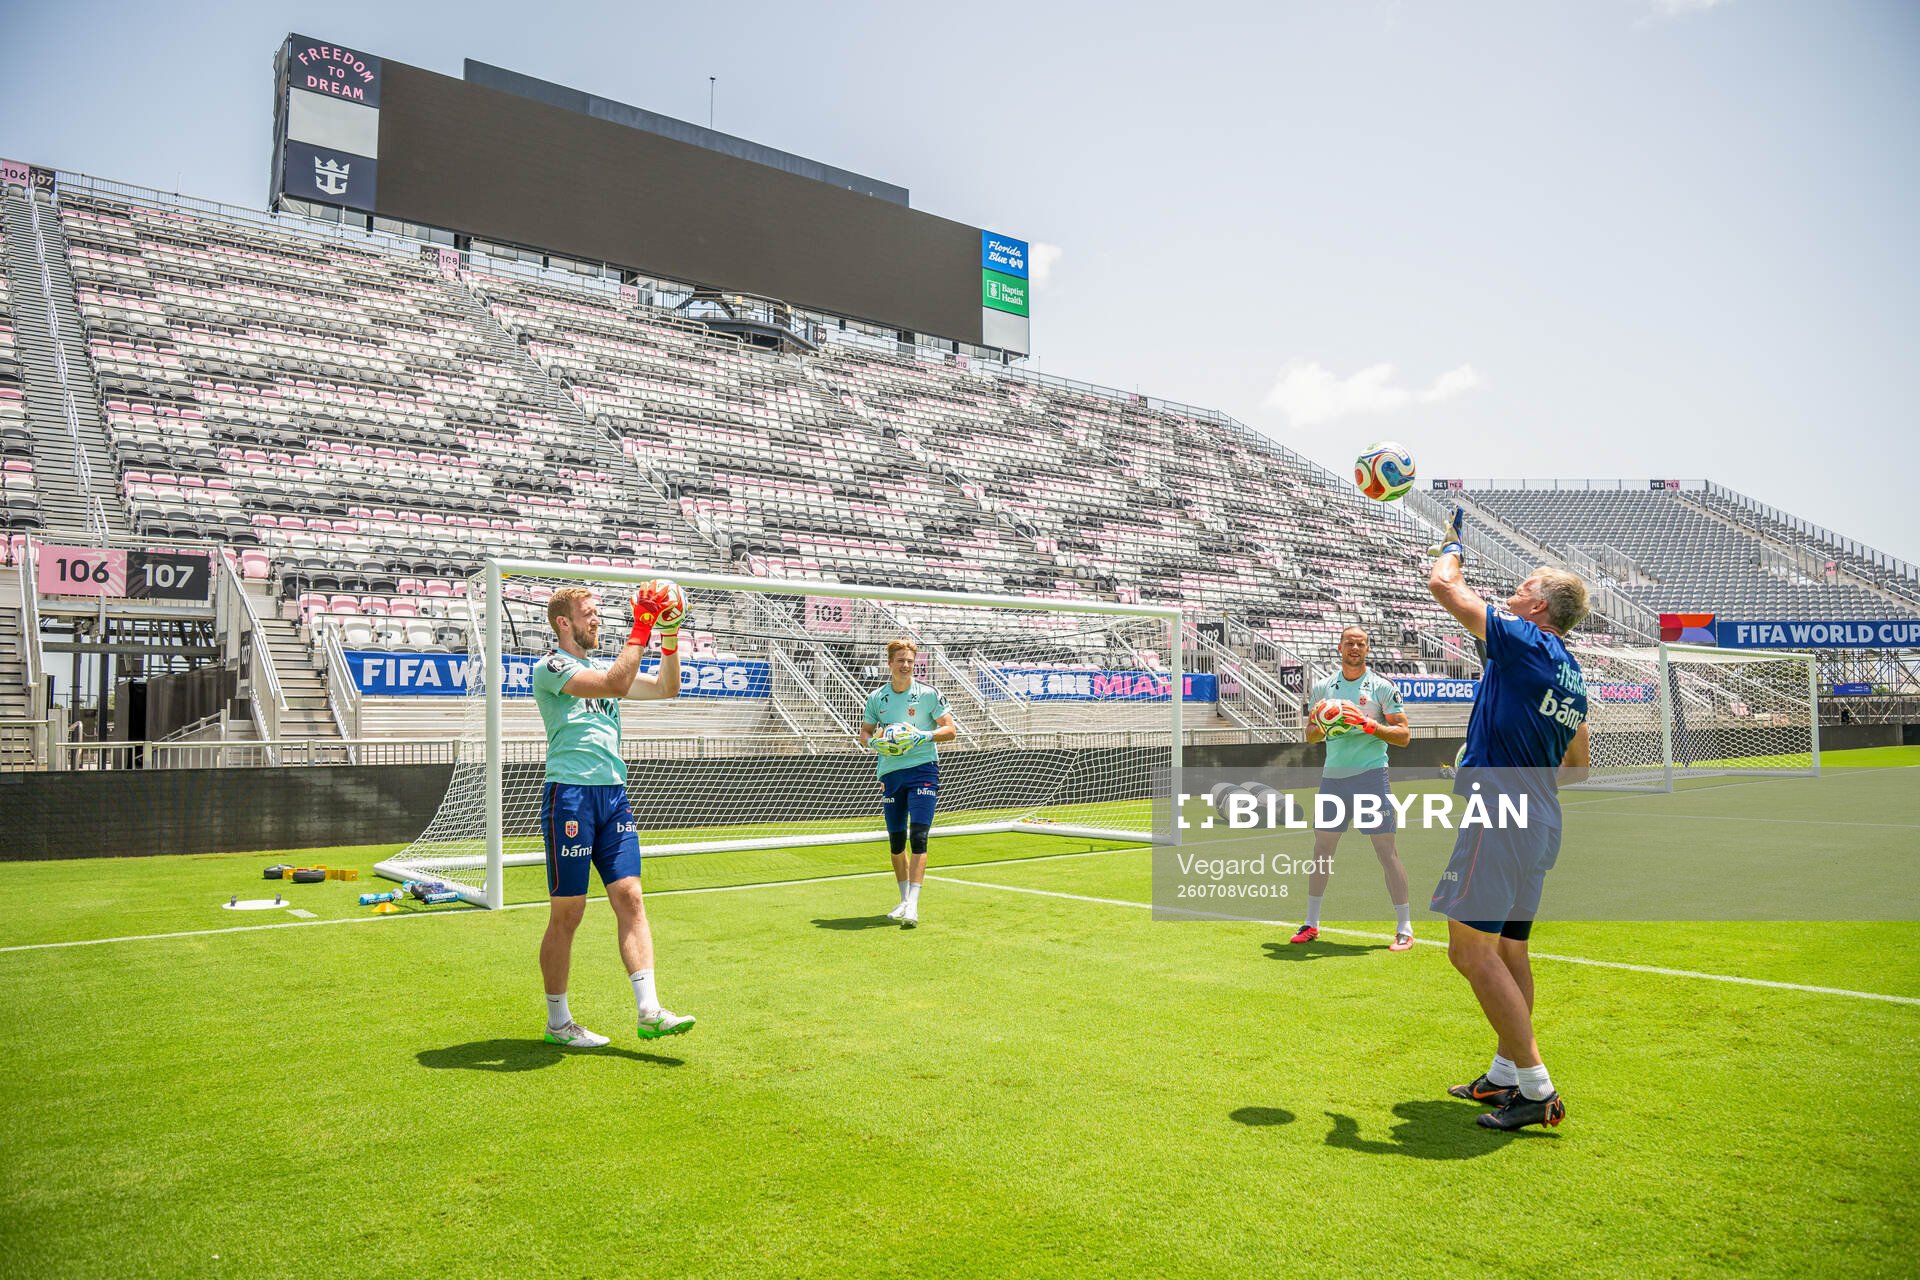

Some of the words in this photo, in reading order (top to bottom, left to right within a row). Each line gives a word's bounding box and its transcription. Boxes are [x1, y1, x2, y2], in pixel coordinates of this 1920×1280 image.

[297, 46, 375, 84] FREEDOM
[327, 65, 345, 79] TO
[306, 75, 364, 101] DREAM
[4, 168, 27, 180] 106
[31, 173, 54, 186] 107
[988, 240, 1023, 257] Florida
[988, 252, 1008, 265] Blue
[1001, 283, 1024, 297] Baptist
[1001, 293, 1023, 306] Health
[56, 558, 110, 584] 106
[142, 564, 194, 588] 107
[814, 604, 843, 623] 108
[1737, 624, 1787, 644] FIFA
[1790, 624, 1874, 644] WORLD
[1877, 624, 1920, 643] CUP
[362, 658, 443, 687] FIFA
[1282, 673, 1301, 686] 109
[1093, 675, 1193, 697] MIAMI
[1413, 681, 1436, 698] CUP
[1436, 682, 1474, 698] 2026
